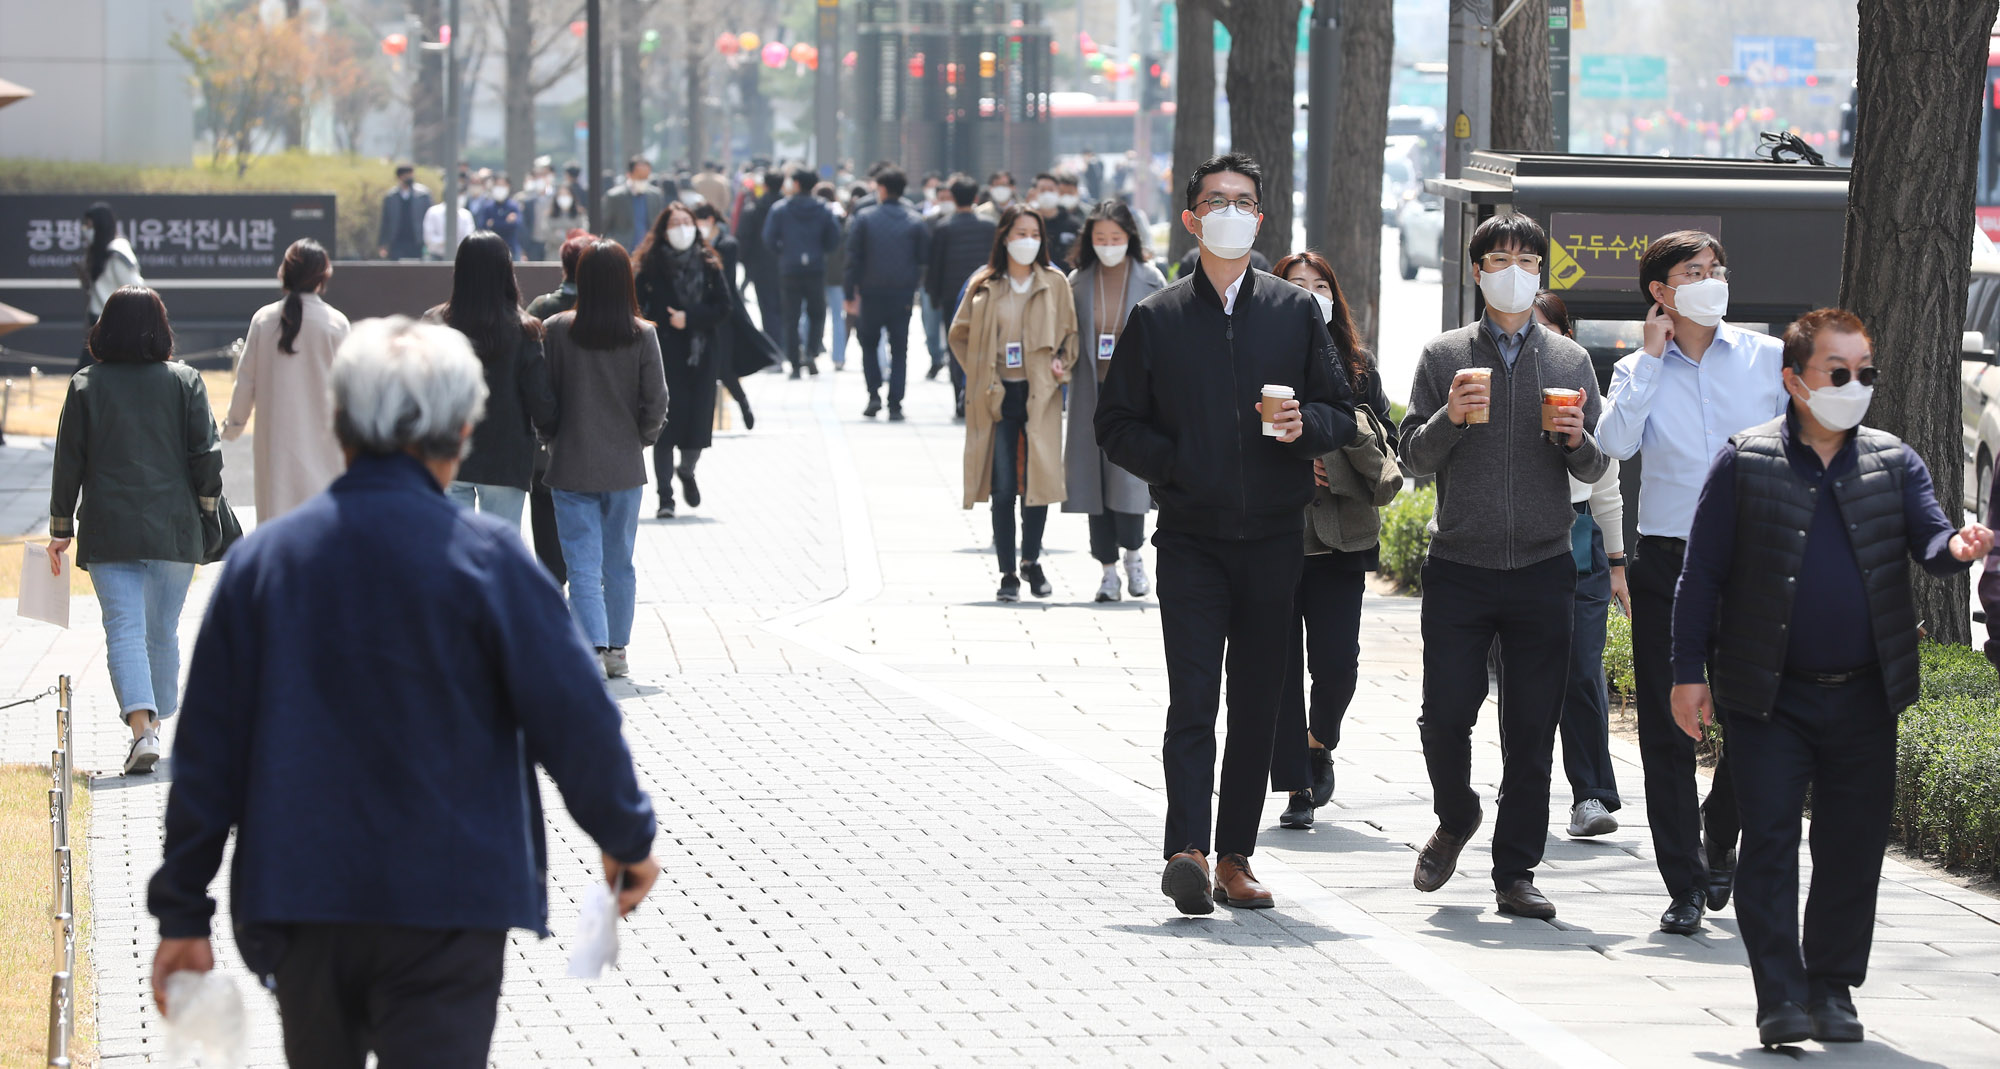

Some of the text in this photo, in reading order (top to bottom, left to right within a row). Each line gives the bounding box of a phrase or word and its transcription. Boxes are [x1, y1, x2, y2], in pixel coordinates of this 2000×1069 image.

[27, 219, 276, 250] 공평시유적전시관
[218, 254, 275, 266] MUSEUM
[1566, 235, 1648, 260] 구두수선
